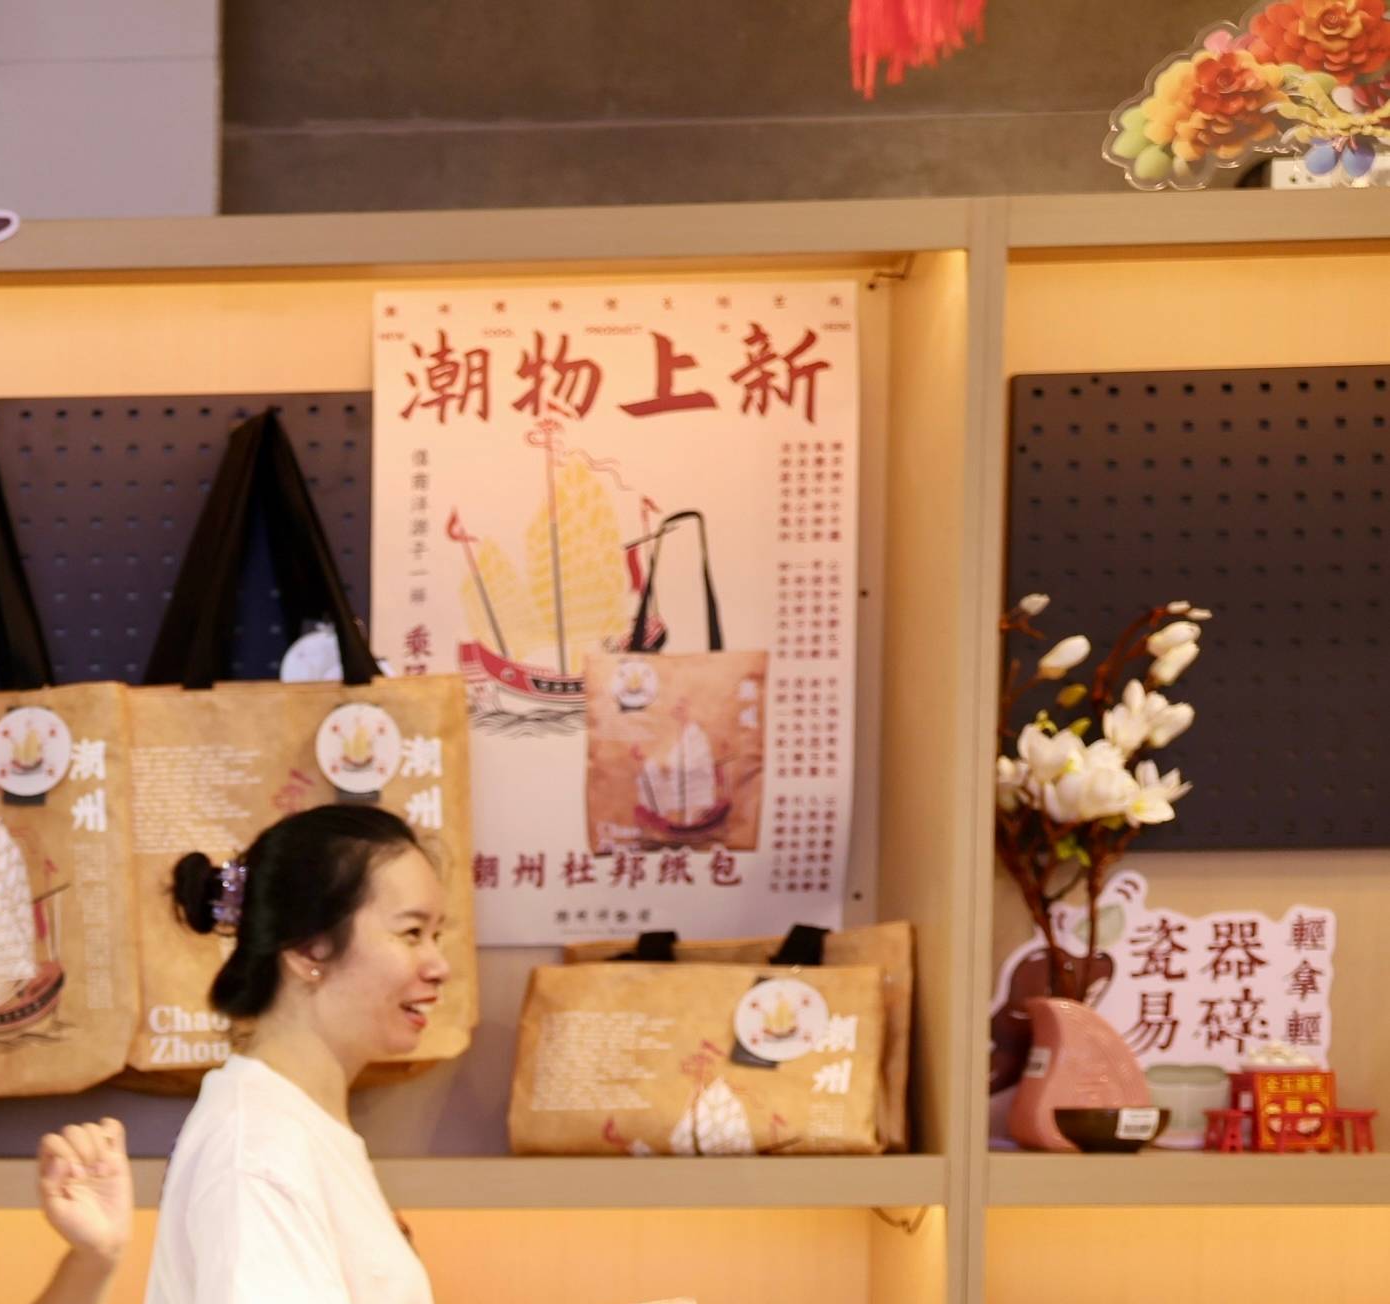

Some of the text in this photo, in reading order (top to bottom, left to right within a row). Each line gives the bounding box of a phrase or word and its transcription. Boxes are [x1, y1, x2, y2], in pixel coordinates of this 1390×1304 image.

[399, 321, 832, 425] 潮物上新
[1129, 917, 1269, 982] 瓷器
[1286, 914, 1328, 1047] 輕拿輕
[148, 1004, 231, 1034] Chao
[148, 1035, 232, 1065] Zhou
[1123, 987, 1271, 1056] 易碎
